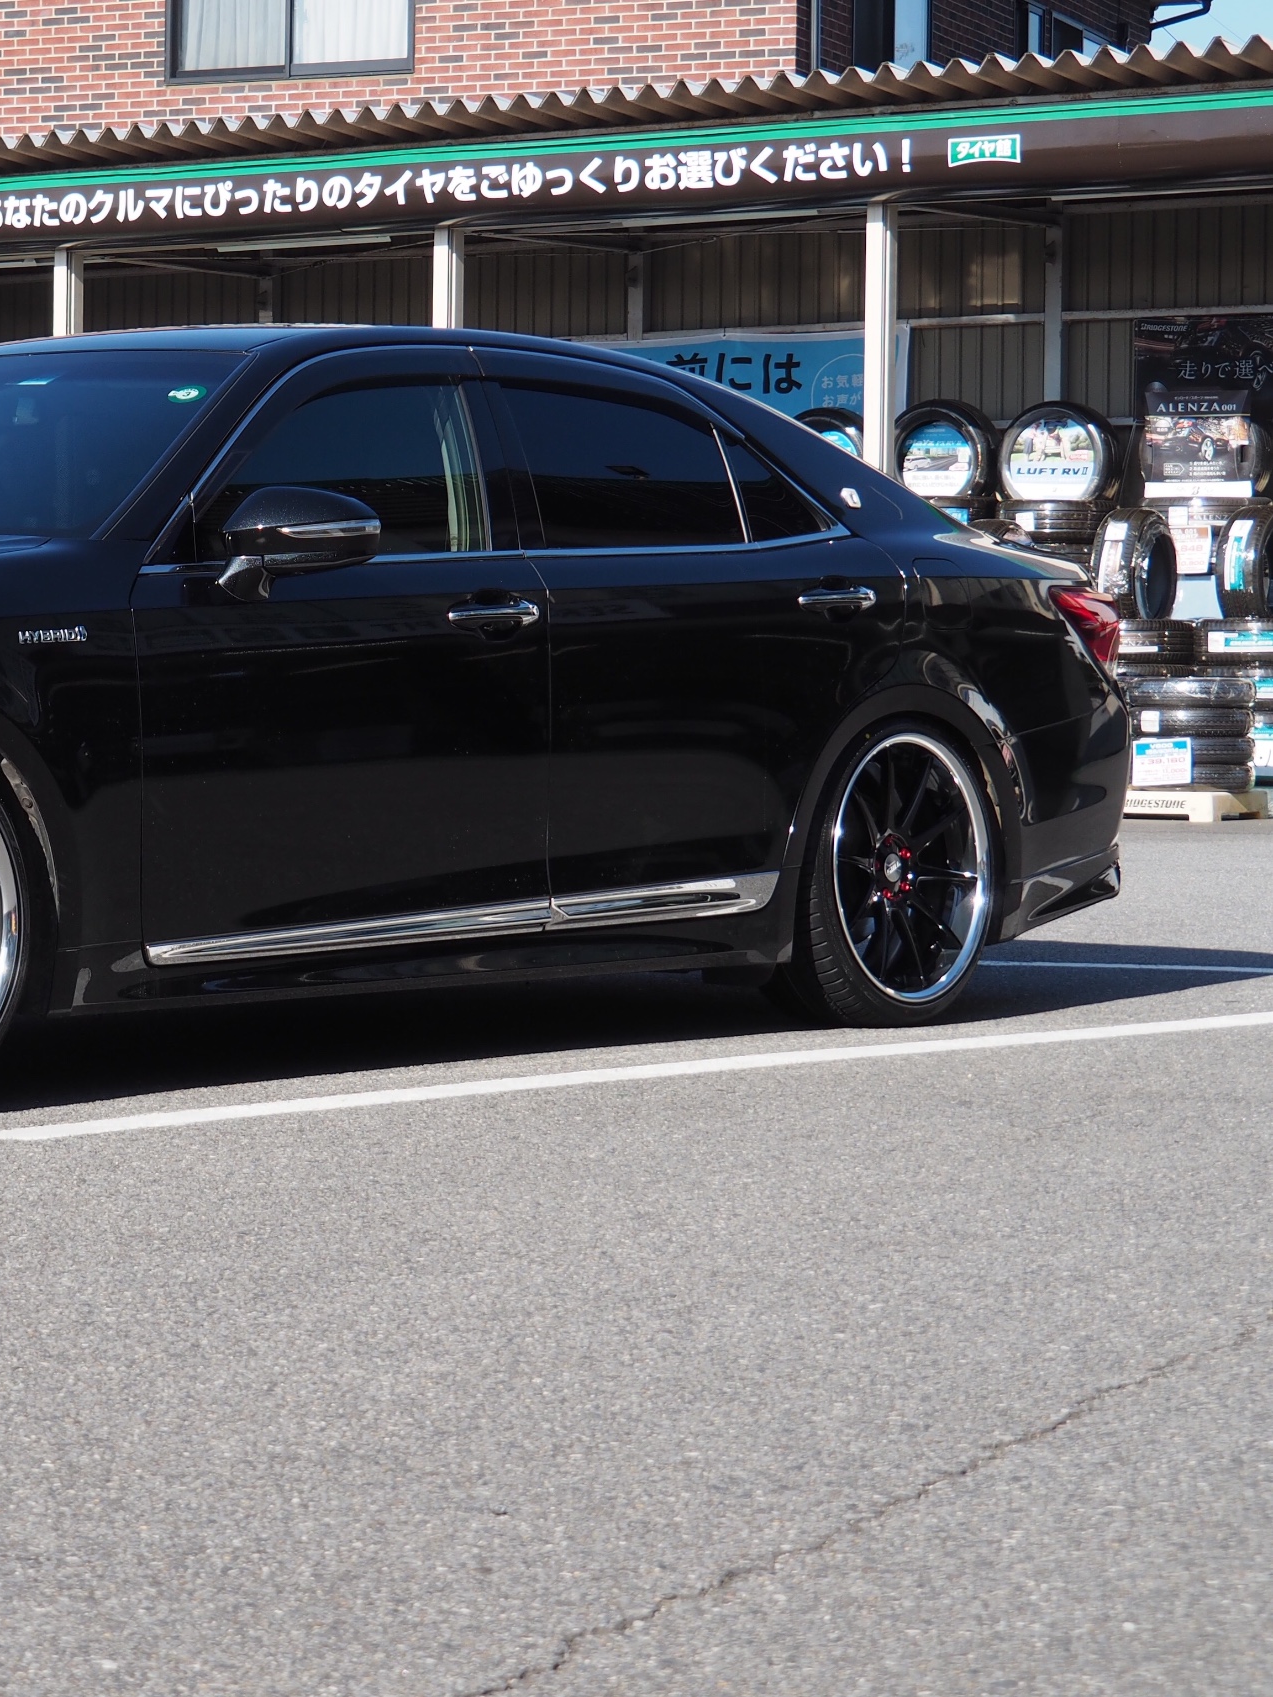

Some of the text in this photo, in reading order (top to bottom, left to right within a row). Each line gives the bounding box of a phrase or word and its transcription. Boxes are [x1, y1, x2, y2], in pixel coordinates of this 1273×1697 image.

[956, 138, 1012, 160] タイヤ館
[1140, 323, 1189, 332] BRIDGESTONE
[1156, 402, 1237, 413] ALENZA 001
[1016, 467, 1059, 475] LUFT
[18, 628, 77, 644] HYBRID
